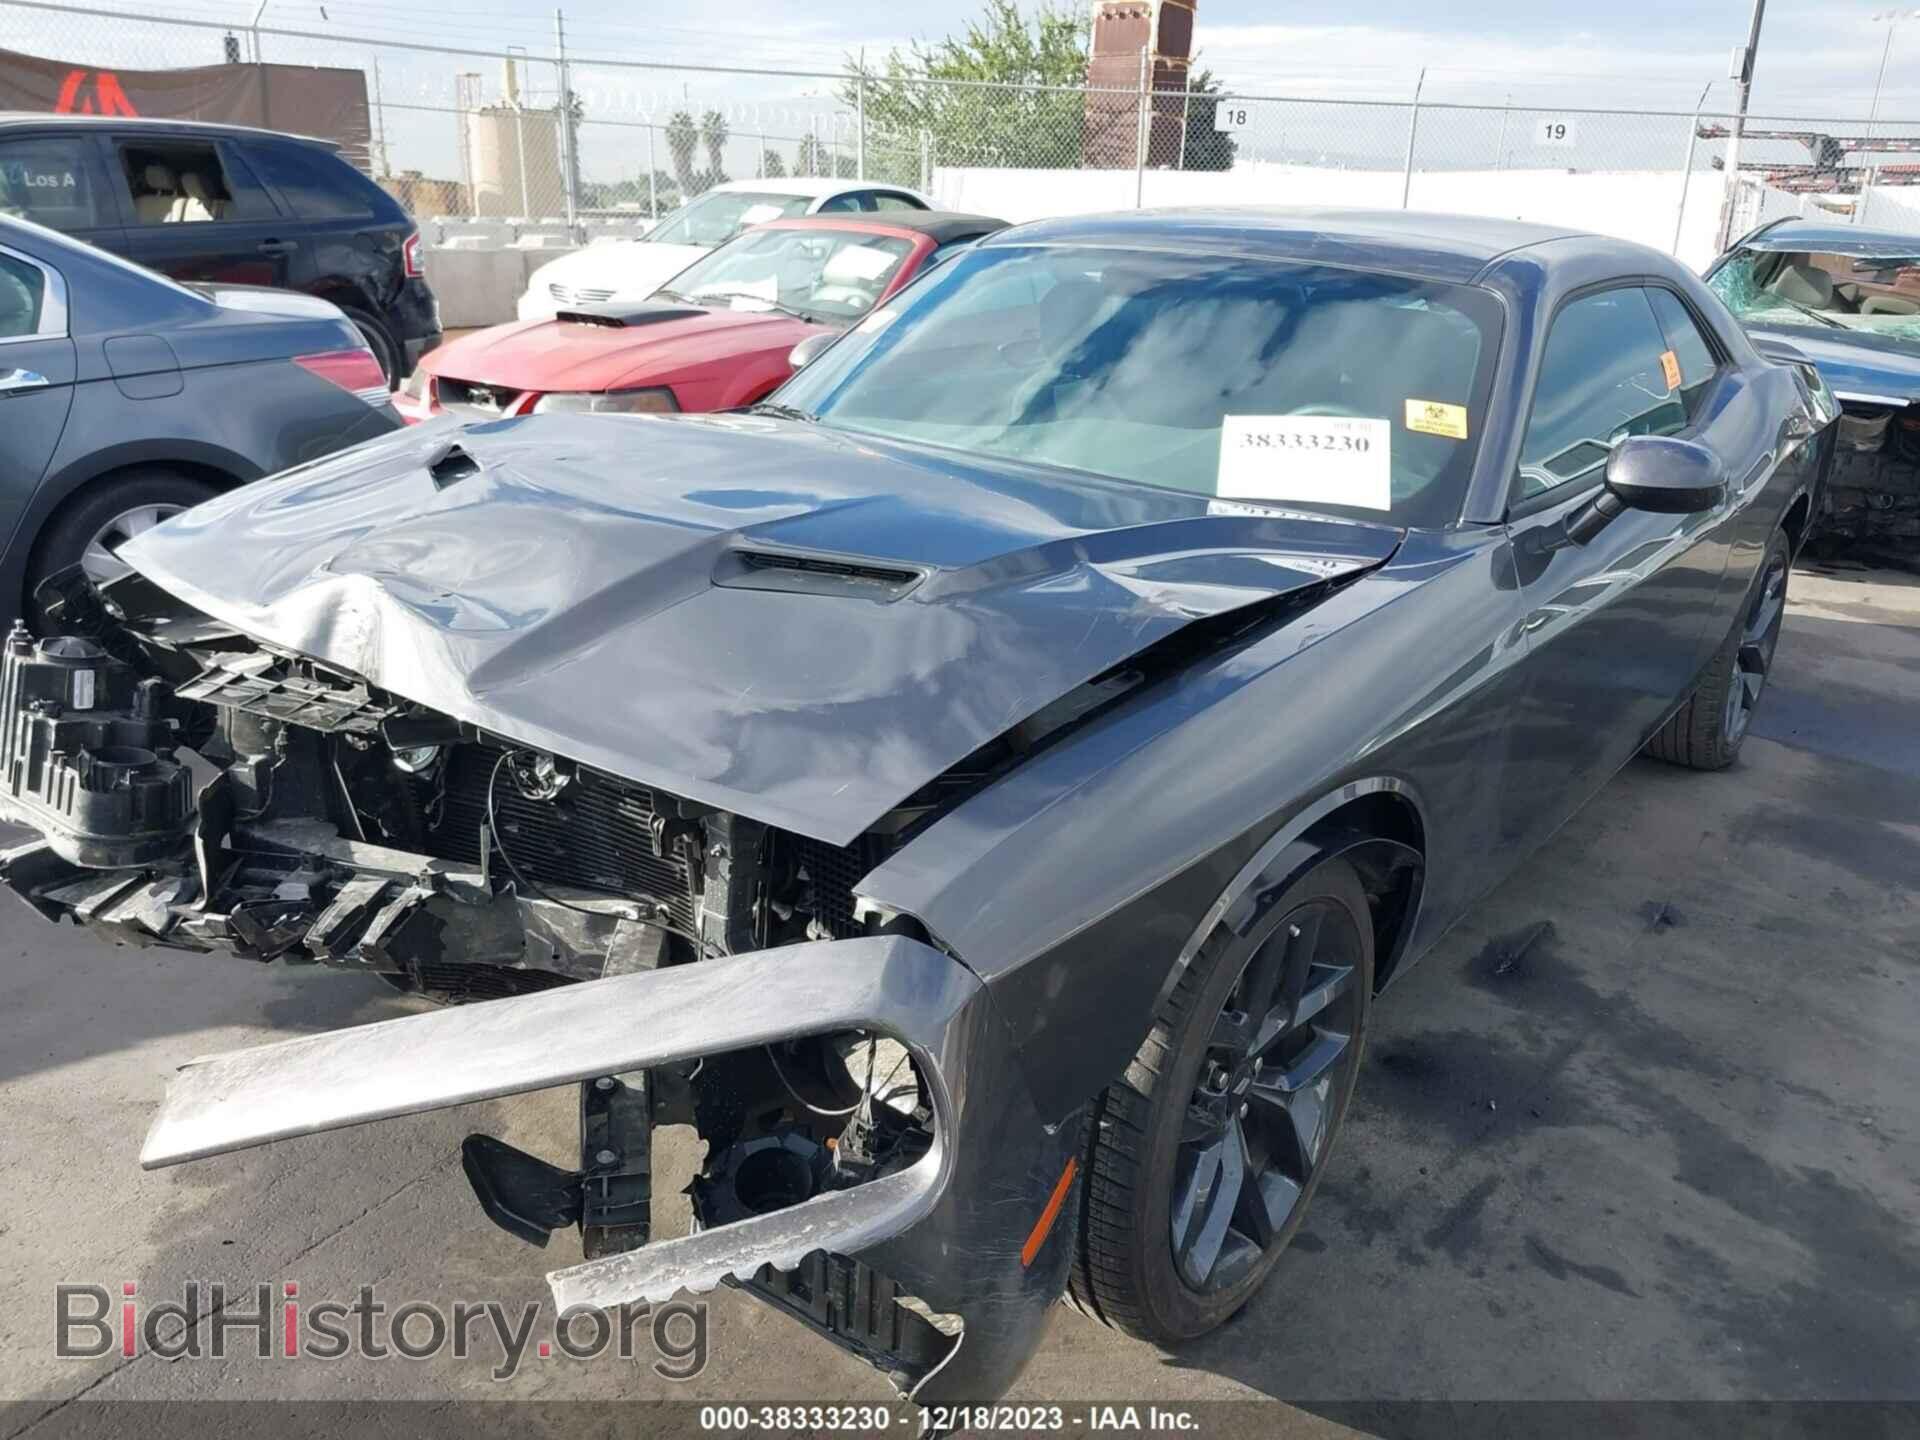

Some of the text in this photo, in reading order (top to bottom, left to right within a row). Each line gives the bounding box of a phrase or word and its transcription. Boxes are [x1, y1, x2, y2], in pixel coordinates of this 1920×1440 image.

[1227, 109, 1247, 125] 18
[1545, 124, 1566, 140] 19
[23, 170, 58, 188] Los
[1240, 432, 1370, 453] 38333230
